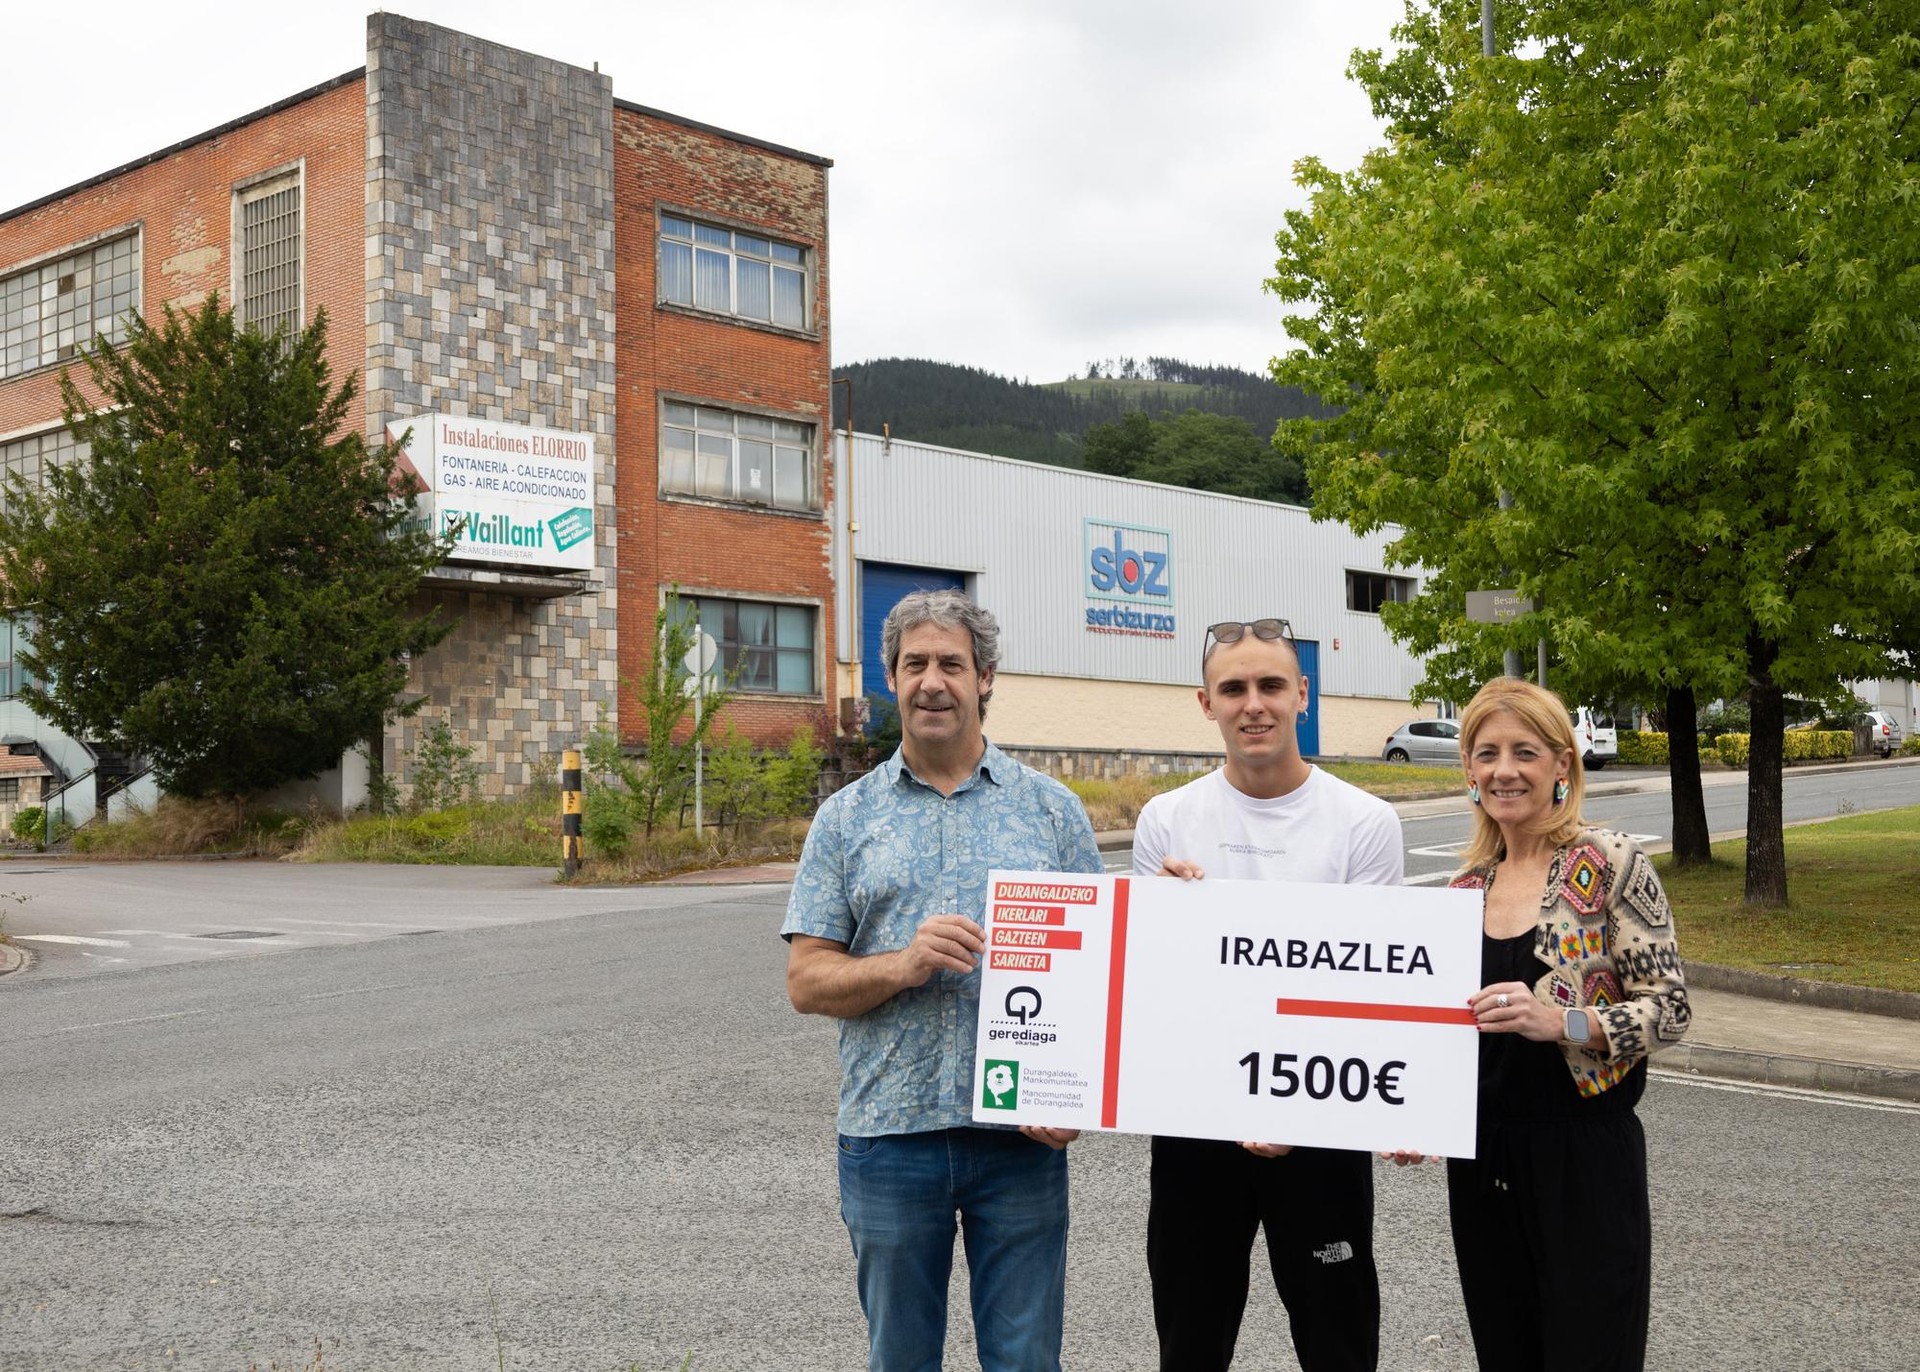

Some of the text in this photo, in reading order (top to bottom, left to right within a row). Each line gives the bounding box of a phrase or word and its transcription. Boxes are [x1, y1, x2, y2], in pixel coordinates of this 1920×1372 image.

[443, 424, 586, 461] Instalaciones ELORRIO
[443, 456, 508, 474] FONTANERIA
[518, 464, 586, 484] CALEFACCION
[444, 474, 466, 486] GAS
[476, 478, 499, 490] AIRE
[502, 480, 586, 500] ACONDICIONADO
[466, 512, 544, 548] Vaillant
[492, 549, 533, 559] BIENESTAR
[1091, 530, 1168, 596] sbz
[998, 885, 1094, 901] DURANGALDEKO
[996, 907, 1048, 922] IKERLARI
[995, 930, 1048, 946] GAZTEEN
[992, 953, 1046, 969] SARIKETA
[1220, 936, 1434, 975] IRABAZLEA
[989, 1030, 1056, 1043] gerediaga
[1024, 1068, 1078, 1078] Durangaldeko
[1238, 1052, 1406, 1105] 1500€
[1022, 1076, 1088, 1087] Mankomunitatea
[1022, 1090, 1081, 1100] Mancomunidad
[1034, 1098, 1084, 1108] Durangaldea
[1313, 1248, 1341, 1258] NORTH
[1324, 1242, 1340, 1252] THE
[1322, 1256, 1342, 1264] FACE
